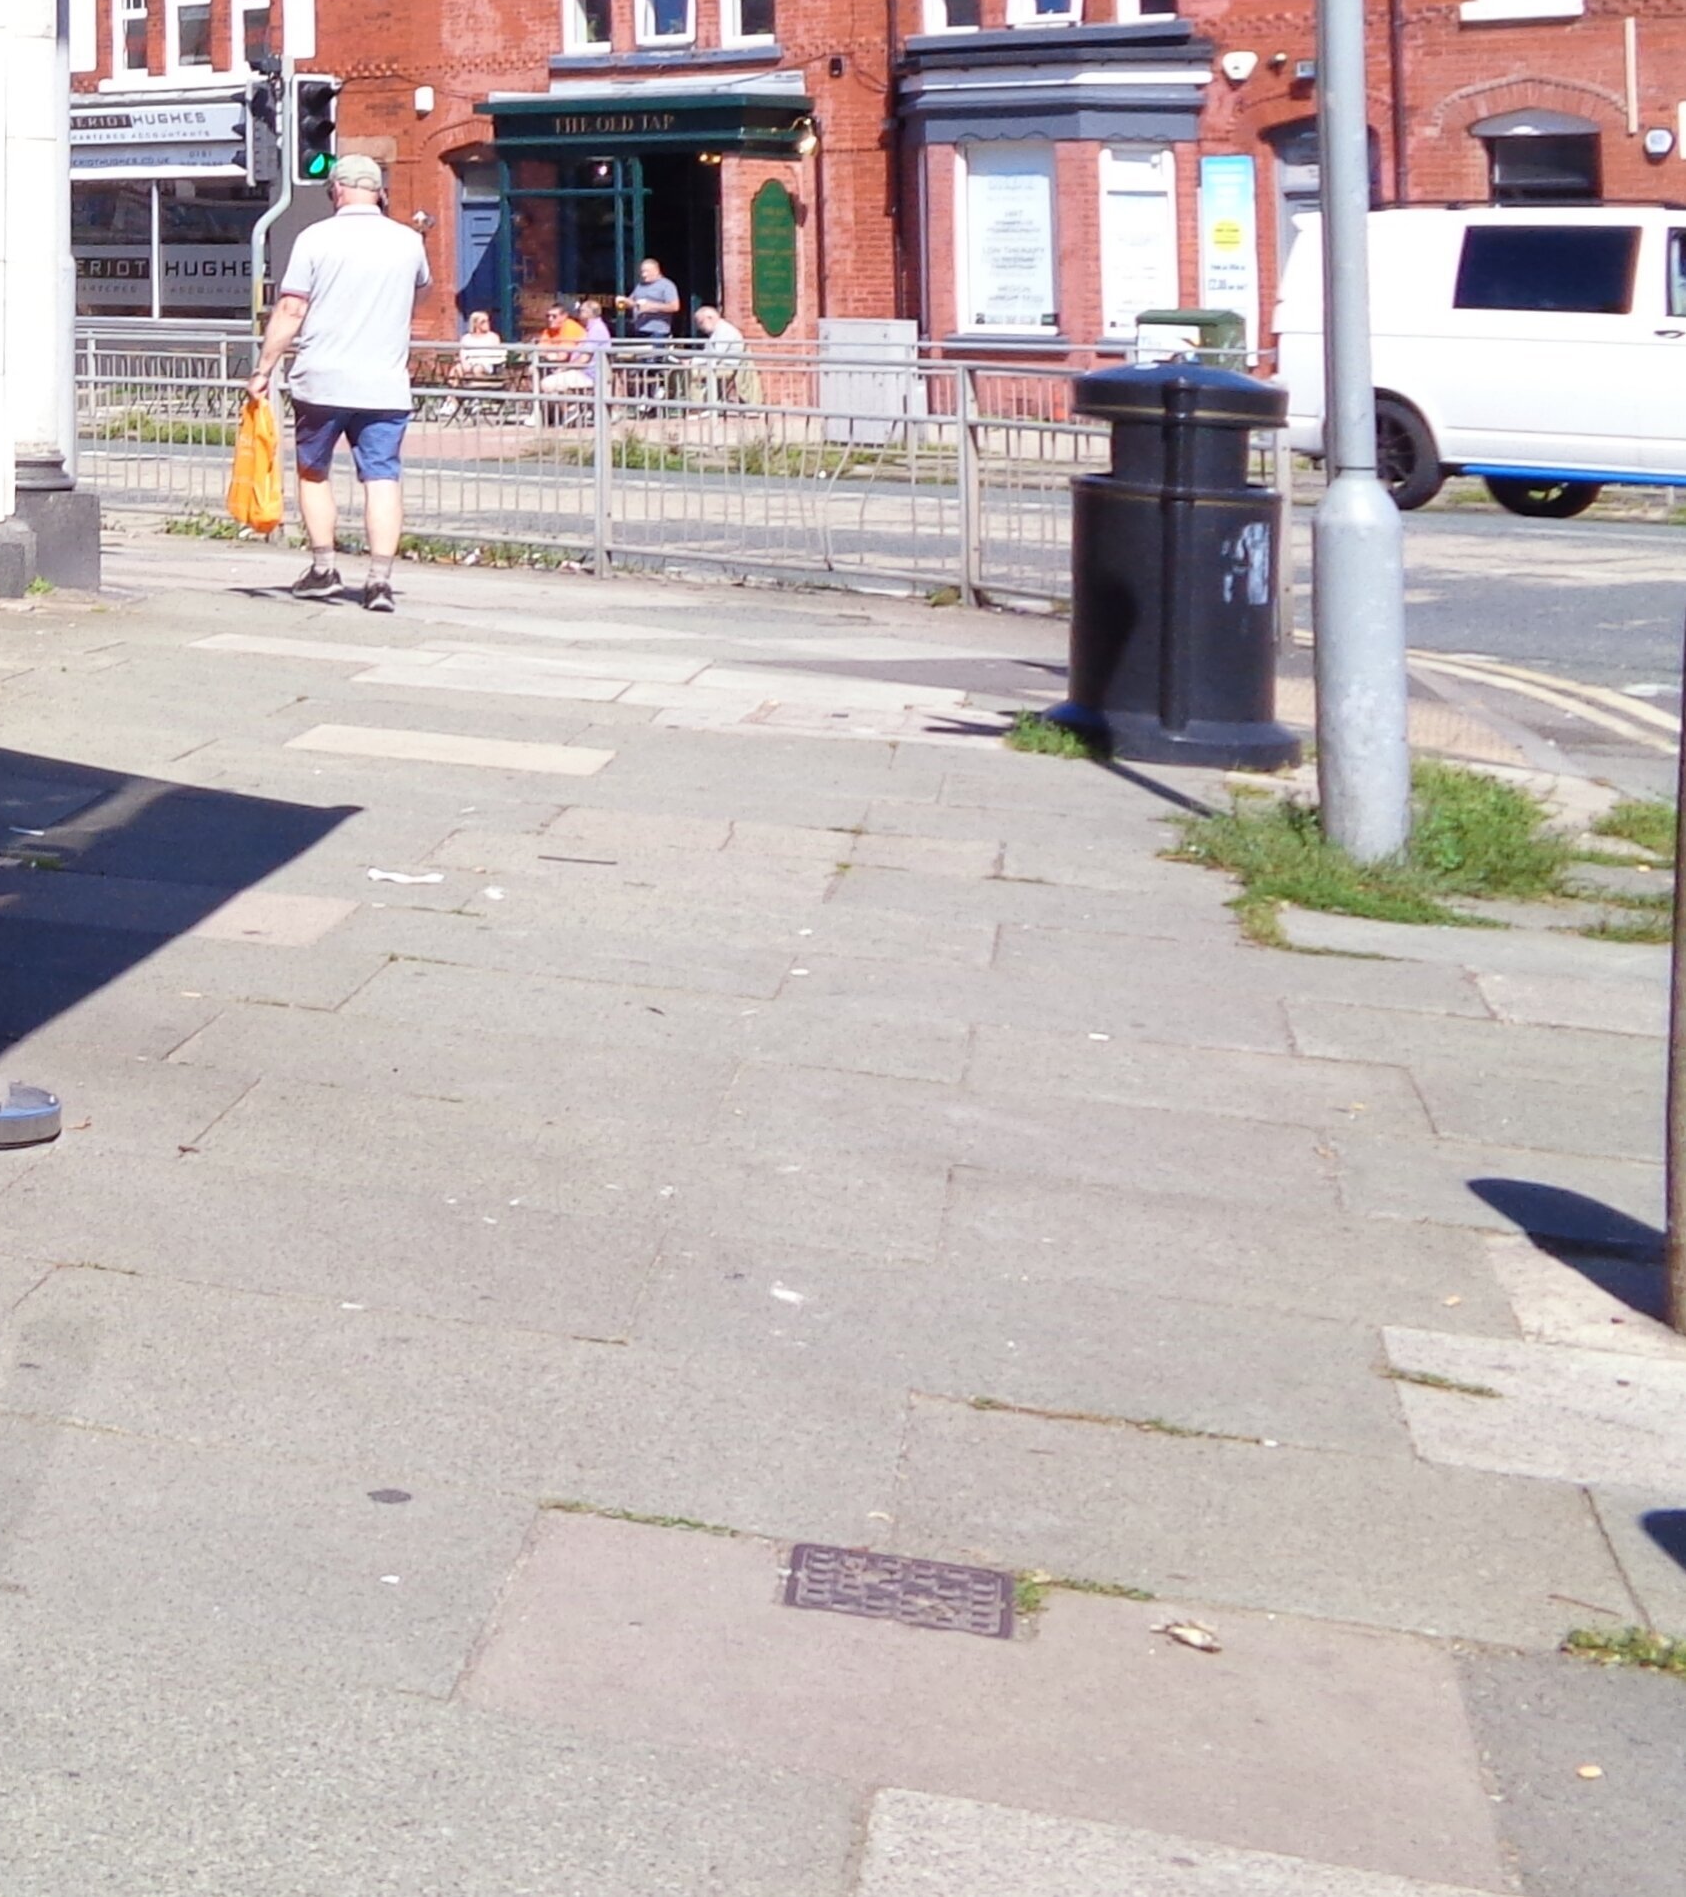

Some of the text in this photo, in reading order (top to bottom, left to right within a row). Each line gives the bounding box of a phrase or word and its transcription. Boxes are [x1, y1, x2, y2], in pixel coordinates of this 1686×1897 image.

[71, 111, 207, 129] ERIOT HUGHES
[596, 115, 634, 133] OLD
[76, 259, 147, 277] ERIOT
